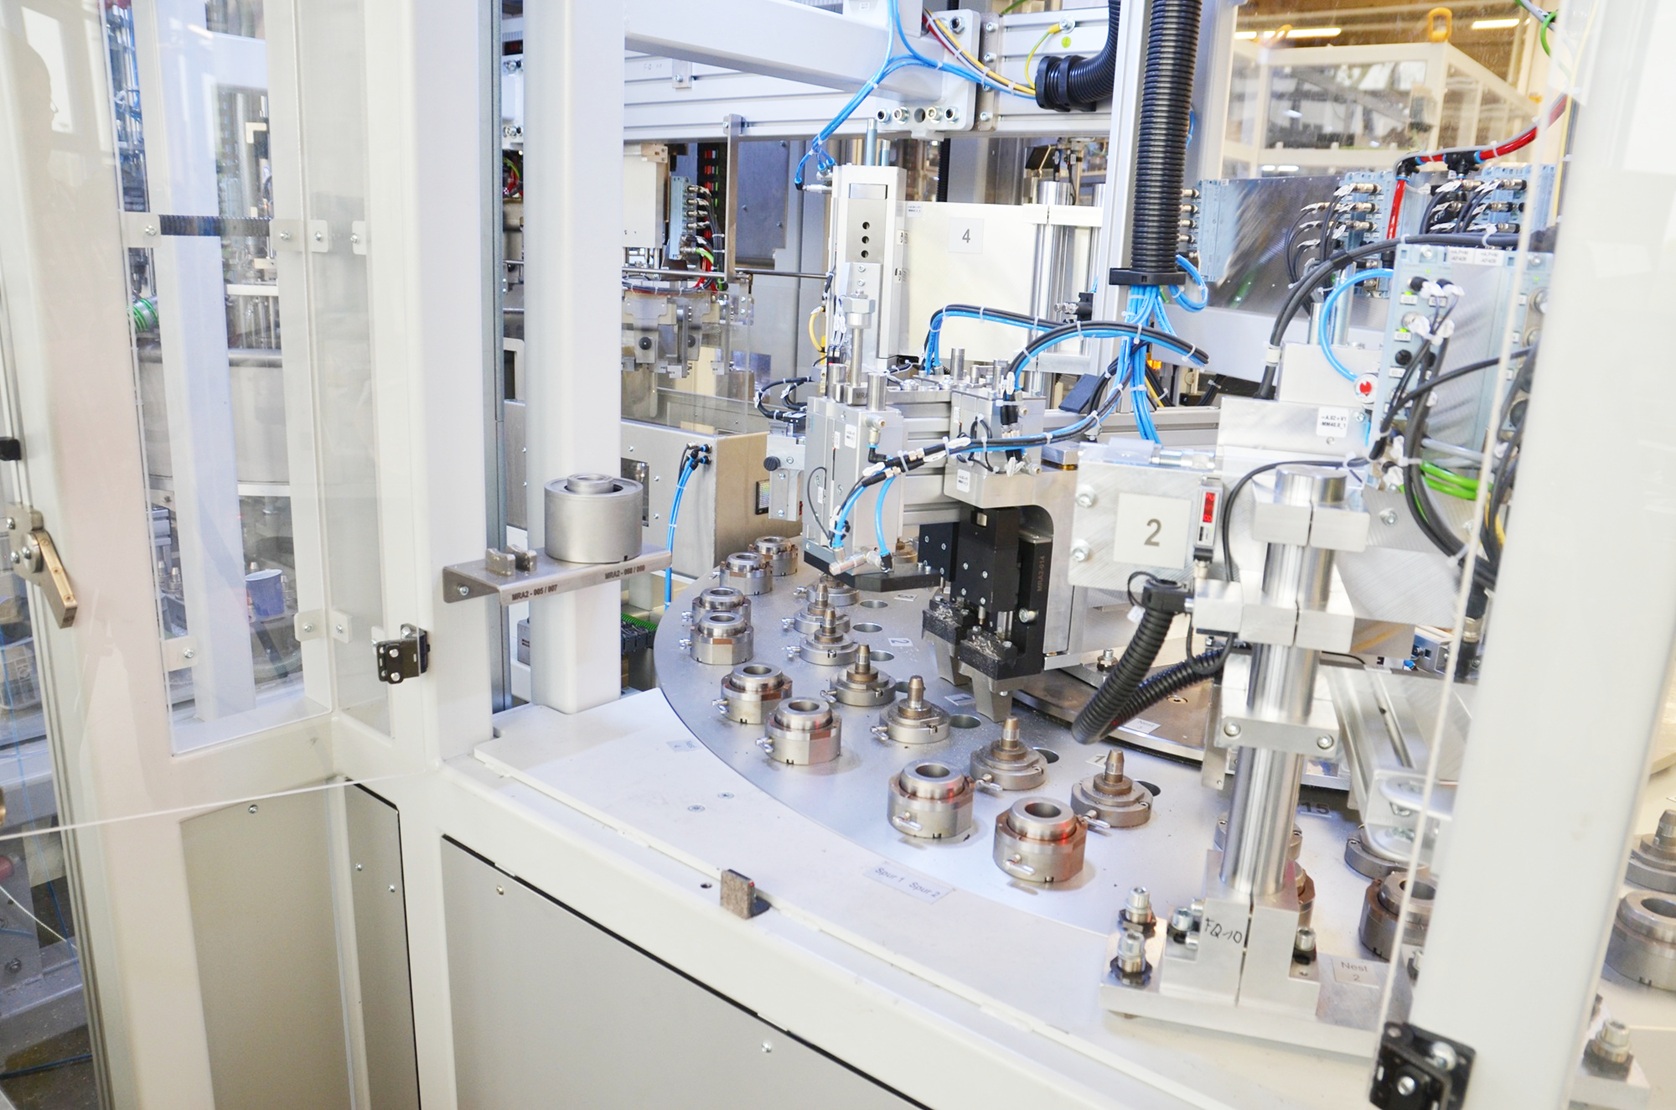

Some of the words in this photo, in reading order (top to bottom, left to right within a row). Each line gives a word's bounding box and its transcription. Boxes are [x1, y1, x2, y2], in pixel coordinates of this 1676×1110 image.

[962, 228, 971, 243] 4
[1144, 518, 1162, 547] 2
[512, 590, 529, 601] MRA2
[547, 584, 558, 592] 007
[1301, 802, 1330, 815] 15
[875, 867, 898, 879] Spur
[909, 882, 932, 894] Spur
[1341, 961, 1368, 972] Nest
[1352, 974, 1361, 982] 2
